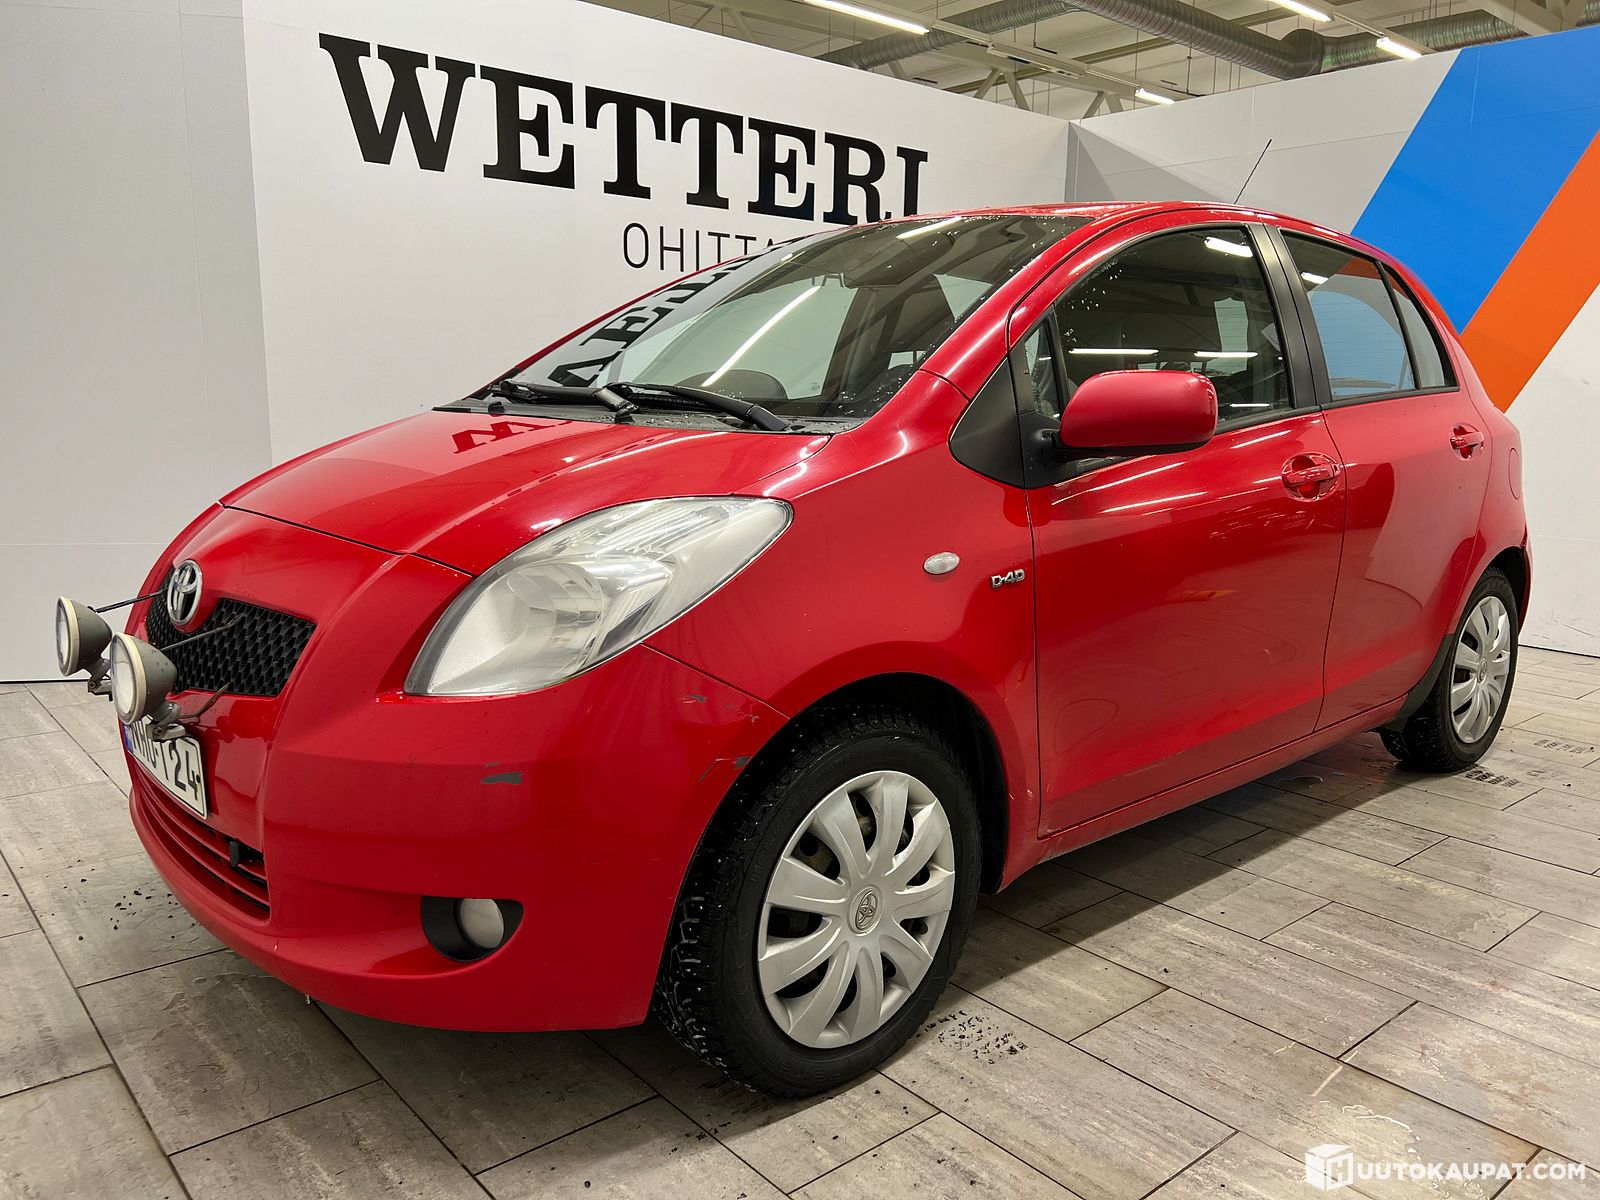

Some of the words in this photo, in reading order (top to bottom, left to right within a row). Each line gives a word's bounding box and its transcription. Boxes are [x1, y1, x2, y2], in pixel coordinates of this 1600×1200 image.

[319, 33, 928, 225] WETTERI
[623, 222, 776, 272] OHITT
[991, 569, 1025, 588] D-4D
